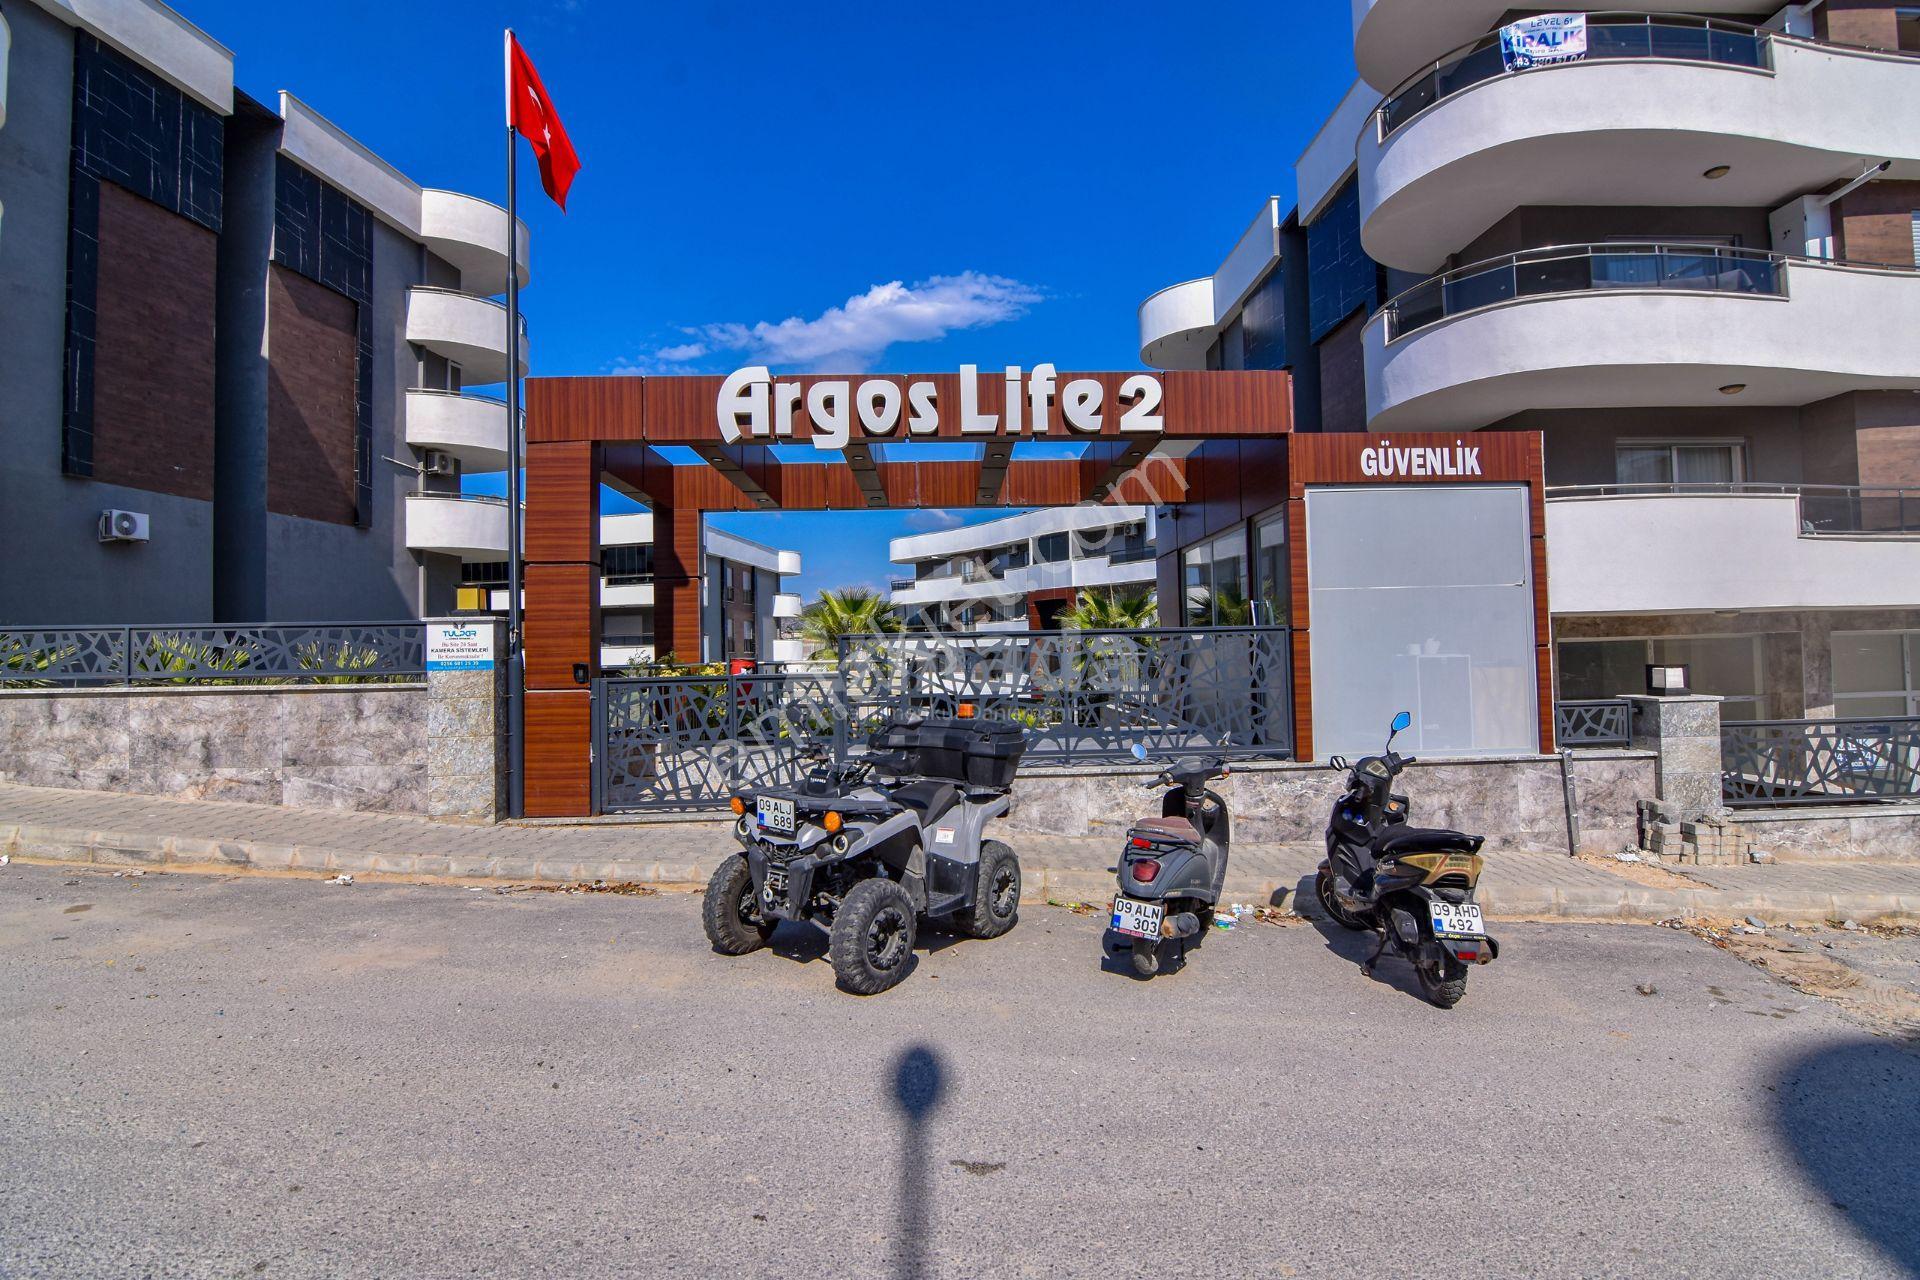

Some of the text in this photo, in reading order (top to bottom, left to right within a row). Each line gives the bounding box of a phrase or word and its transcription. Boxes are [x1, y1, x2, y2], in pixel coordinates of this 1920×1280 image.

[1531, 17, 1561, 28] LEVEL
[717, 362, 1165, 451] Argos Life 2
[1360, 439, 1482, 476] GÜVENLİK
[759, 799, 792, 815] 09 ALJ
[773, 815, 792, 829] 689
[1117, 901, 1159, 919] 09 ALN
[1433, 904, 1479, 918] 09 AHD
[1133, 918, 1157, 933] 303
[1449, 918, 1474, 932] 492
